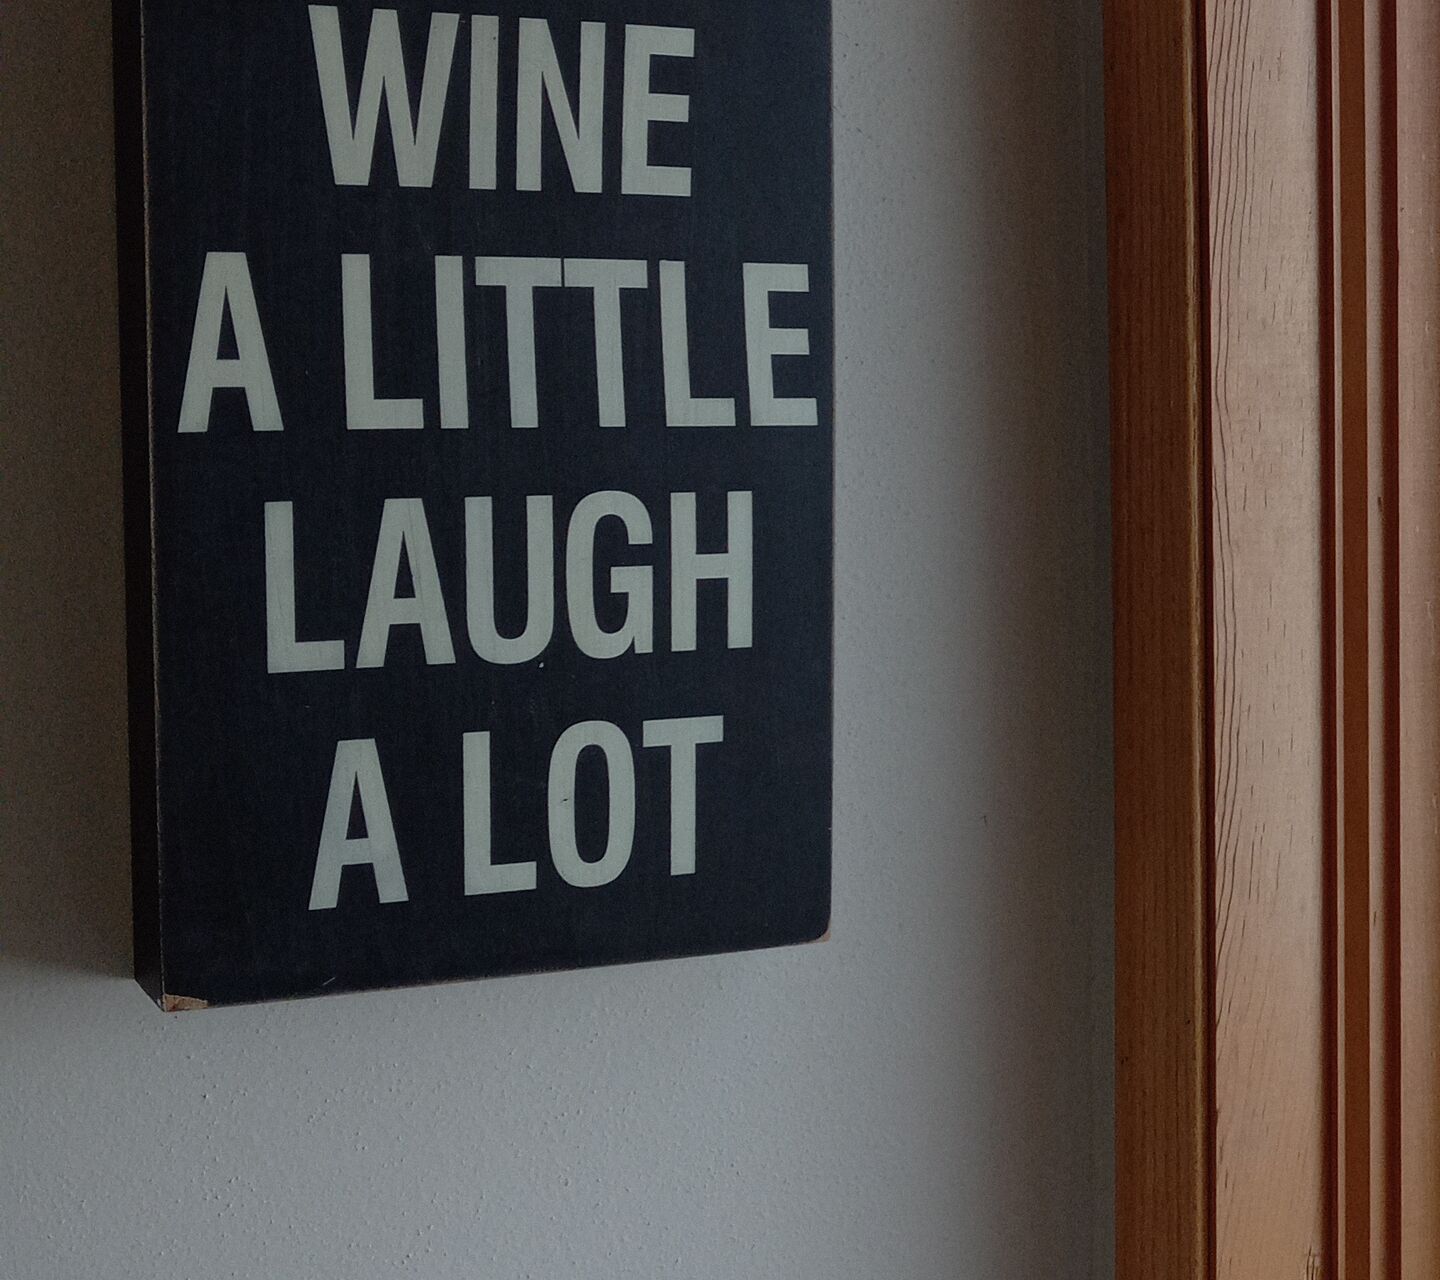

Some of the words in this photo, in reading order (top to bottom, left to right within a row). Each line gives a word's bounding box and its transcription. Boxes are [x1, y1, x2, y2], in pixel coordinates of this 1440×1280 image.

[307, 4, 696, 198] WINE
[177, 250, 284, 433] A
[341, 253, 818, 430] LITTLE
[264, 490, 754, 675] LAUGH
[307, 738, 409, 912] A
[462, 715, 724, 896] LOT
